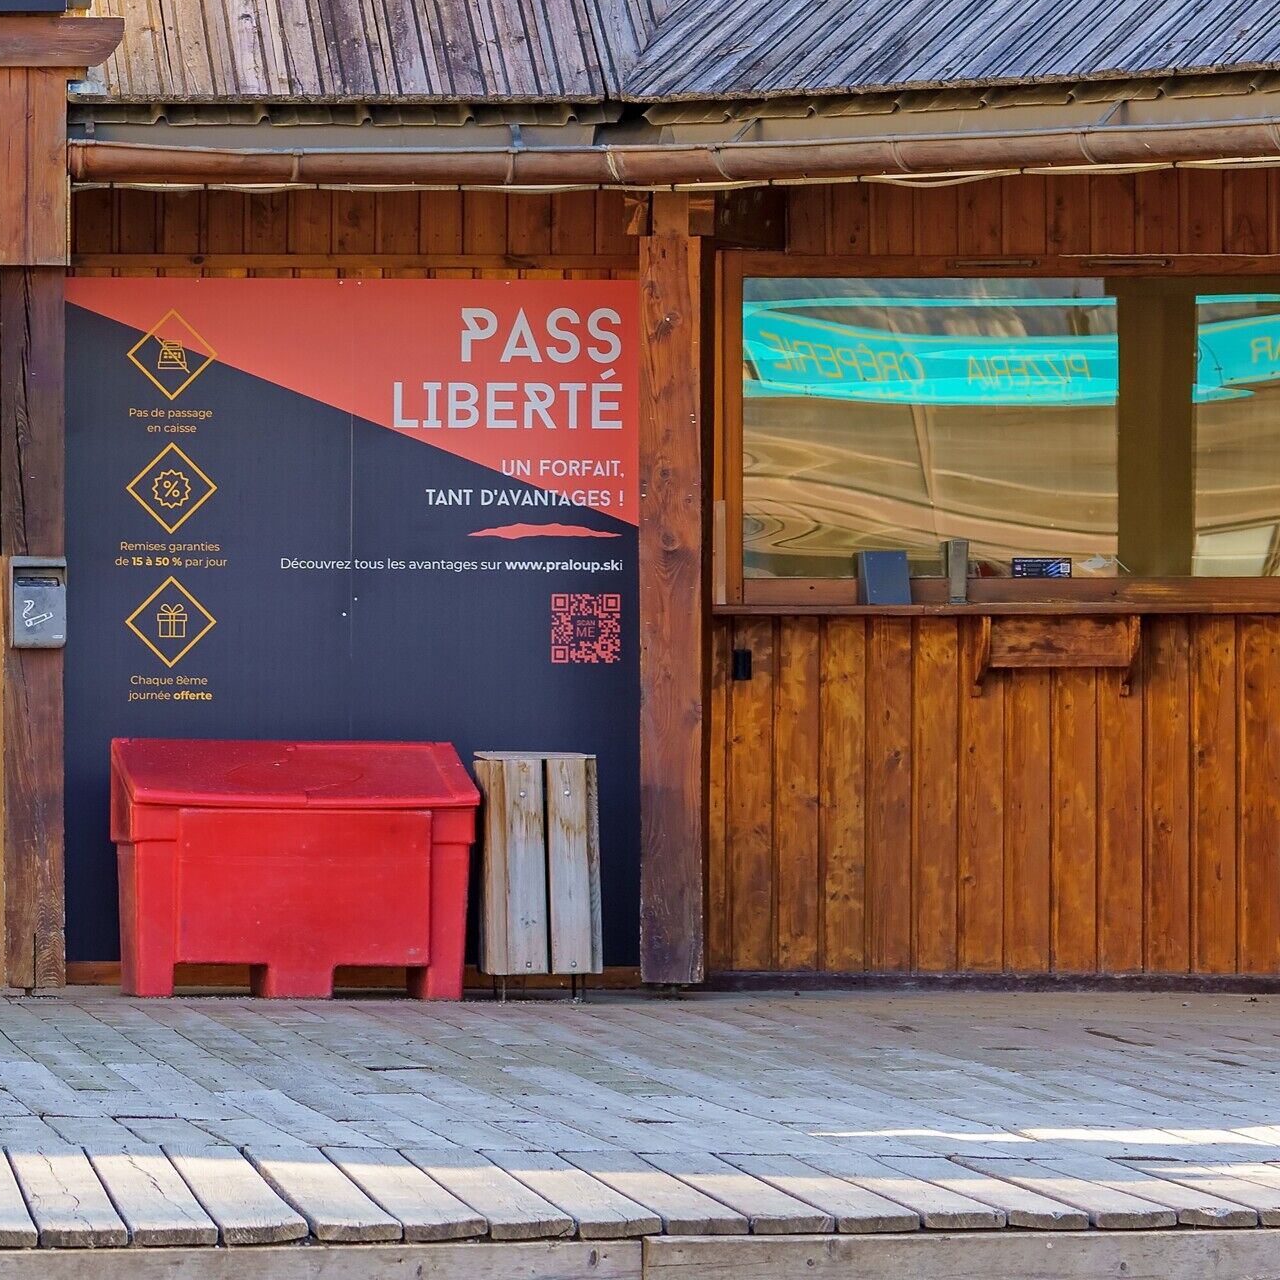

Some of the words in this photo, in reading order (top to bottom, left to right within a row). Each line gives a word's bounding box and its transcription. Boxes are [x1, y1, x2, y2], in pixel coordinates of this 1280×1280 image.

[461, 307, 621, 363] PASS
[393, 368, 622, 429] LIBERTÉ
[129, 408, 149, 417] Pas
[151, 408, 165, 417] de
[167, 410, 213, 420] passage
[164, 423, 197, 432] caisse
[501, 460, 531, 476] UN
[539, 460, 625, 478] FORFAIT,
[426, 489, 473, 506] TANT
[480, 489, 611, 507] D'AVANTAGES
[120, 541, 166, 551] Remises
[168, 542, 220, 553] garanties
[114, 557, 129, 566] de
[131, 557, 143, 566] 15
[145, 556, 152, 566] à
[155, 557, 170, 566] 50
[172, 557, 183, 566] %
[185, 559, 202, 568] par
[204, 557, 227, 568] jour
[280, 558, 351, 569] Découvrez
[354, 558, 384, 569] tous
[387, 558, 406, 569] les
[408, 560, 478, 572] avantages
[480, 561, 502, 570] sur
[505, 559, 623, 573] www.praloup.ski
[576, 627, 596, 637] ME
[130, 675, 173, 686] Chaque
[176, 675, 208, 685] 8ème
[128, 690, 171, 702] journée
[173, 690, 213, 700] offerte
